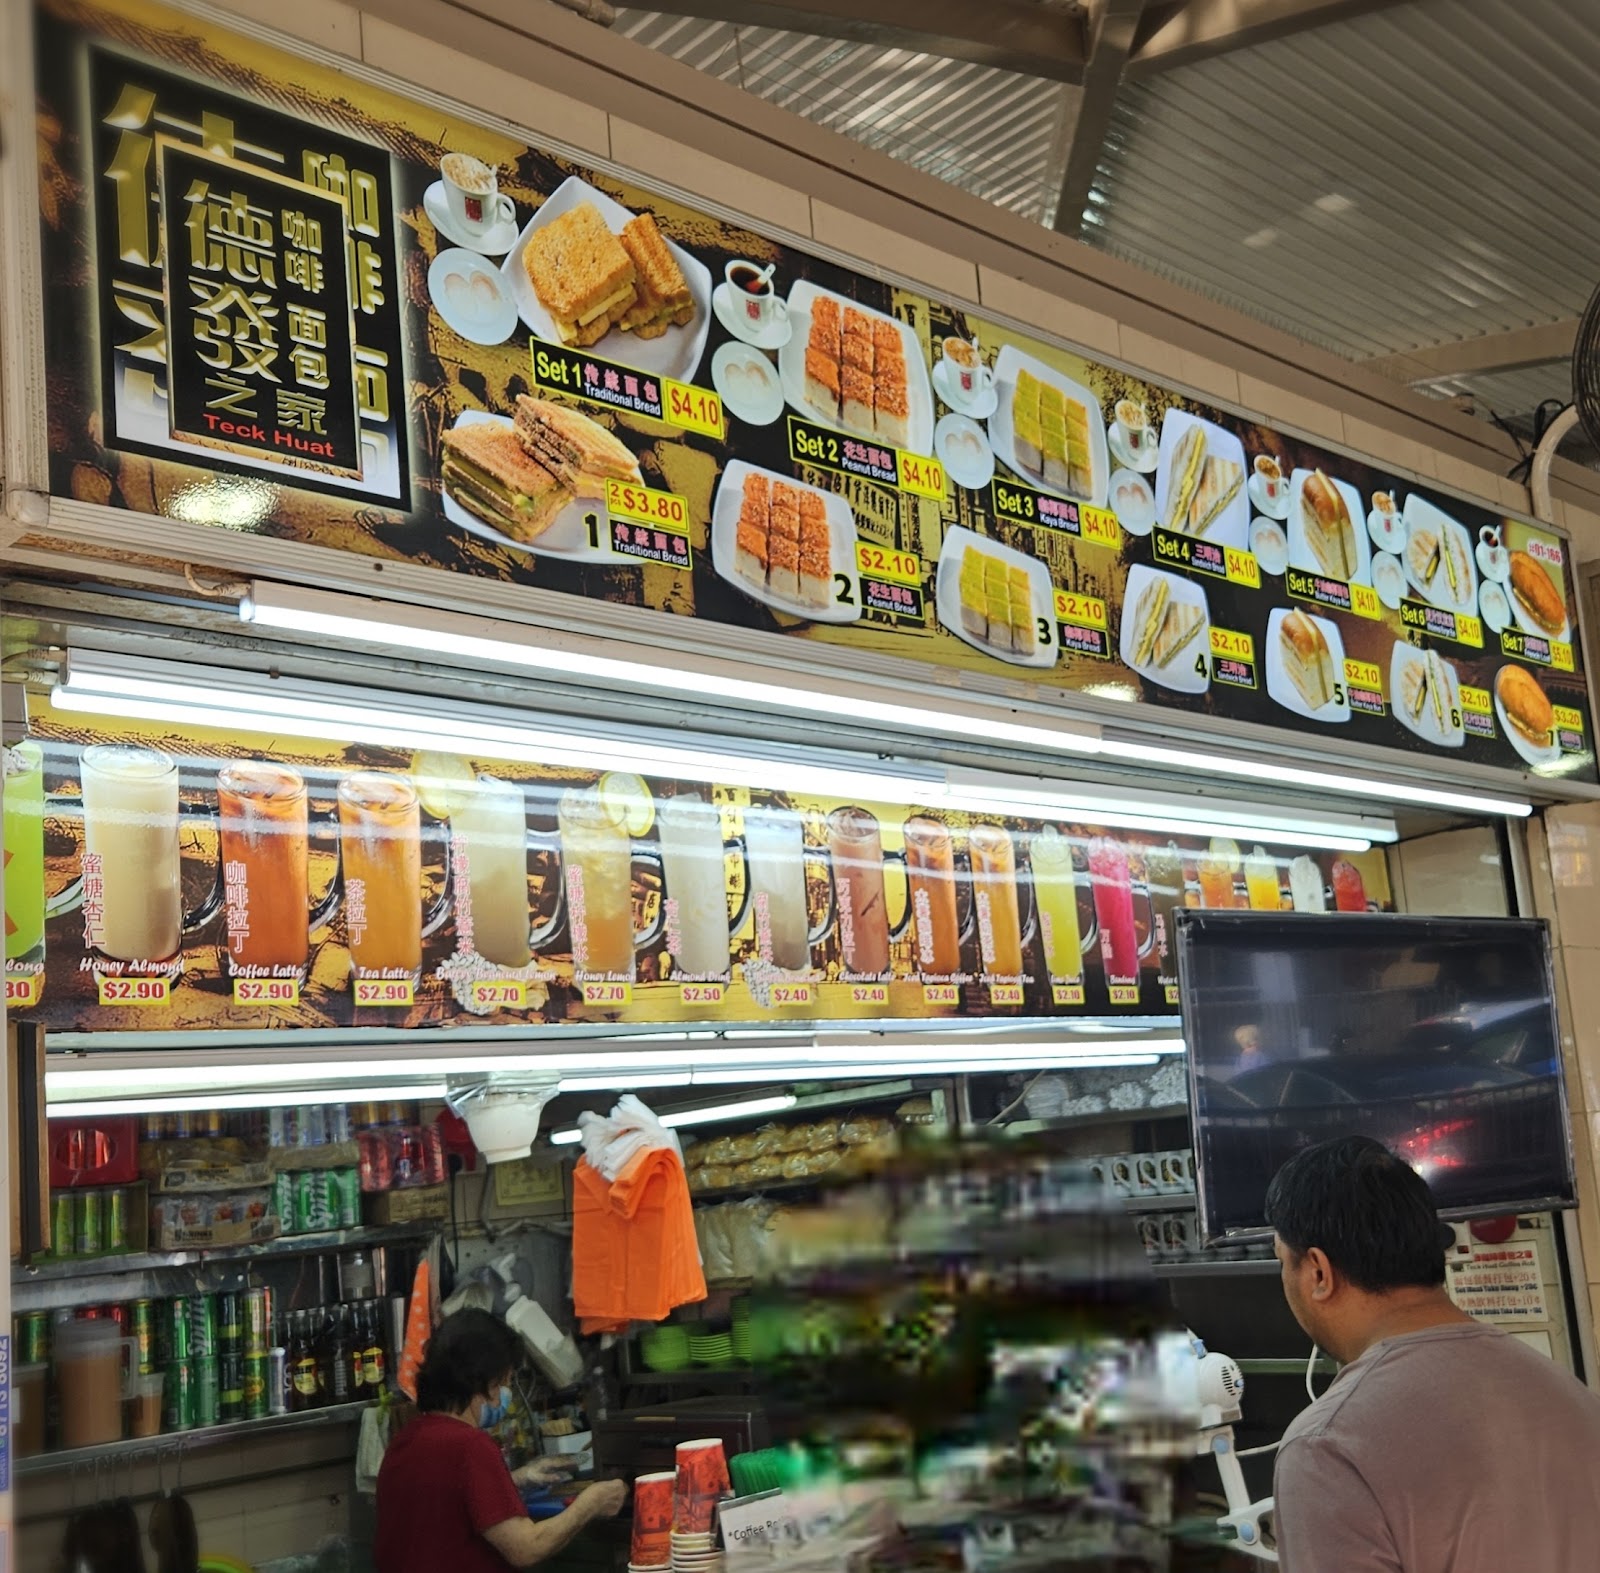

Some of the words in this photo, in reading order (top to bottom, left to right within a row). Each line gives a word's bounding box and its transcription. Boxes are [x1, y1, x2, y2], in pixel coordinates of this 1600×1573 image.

[536, 351, 570, 385] Set
[571, 362, 582, 388] 1
[583, 382, 634, 409] Traditional
[633, 398, 662, 417] Bread
[671, 387, 719, 426] $4.10
[202, 413, 267, 442] Teck
[274, 430, 336, 458] Huat
[795, 429, 826, 459] Set
[827, 438, 839, 463] 2
[841, 457, 872, 475] Peanut
[871, 466, 897, 482] Bread
[902, 458, 941, 491] $4.10
[623, 487, 683, 522] $3.80
[997, 488, 1023, 515] Set
[1024, 495, 1034, 517] 3
[584, 513, 599, 548] 1
[1084, 511, 1116, 540] $4.10
[613, 540, 661, 560] Traditional
[661, 551, 689, 566] Bread
[1156, 533, 1180, 559] Set
[1180, 542, 1191, 561] 4
[860, 547, 916, 576] $2.10
[1228, 553, 1256, 579] $4.10
[833, 573, 855, 606] 2
[1288, 573, 1307, 594] Set
[1307, 578, 1314, 595] 5
[866, 595, 893, 611] Peanut
[1056, 595, 1102, 620] $2.10
[1401, 603, 1418, 624] Set
[1418, 609, 1425, 626] 6
[1036, 617, 1052, 646] 3
[1211, 631, 1250, 655] $2.10
[1503, 632, 1518, 651] Set
[1194, 653, 1207, 678] 4
[1345, 663, 1378, 684] $2.10
[1333, 683, 1345, 706] 5
[1460, 689, 1488, 708] $2.10
[1450, 708, 1460, 728] 6
[81, 852, 105, 949] 蜜糖杏仁
[225, 860, 249, 953] 咖啡拉丁
[346, 878, 367, 945] 茶拉丁
[79, 957, 124, 975] Honey
[128, 958, 184, 977] Almond
[228, 963, 270, 979] Coffee
[273, 963, 303, 979] Latte
[359, 966, 379, 979] Tea
[381, 966, 411, 980] Latte
[575, 970, 605, 983] Honey
[607, 970, 636, 982] Lemon
[669, 970, 706, 982] Almond
[103, 981, 165, 1000] $2.90
[238, 982, 293, 1000] $2.90
[358, 984, 408, 1000] $2.90
[477, 986, 519, 1003] $2.70
[586, 986, 625, 1001] $2.70
[683, 987, 721, 1001] $2.50
[774, 988, 808, 1001] $2.40
[853, 989, 885, 1001] $2.40
[926, 988, 955, 1000] $2.40
[993, 989, 1020, 1000] $2.40
[1056, 989, 1080, 1000] $2.10
[1112, 989, 1136, 1000] $2.10
